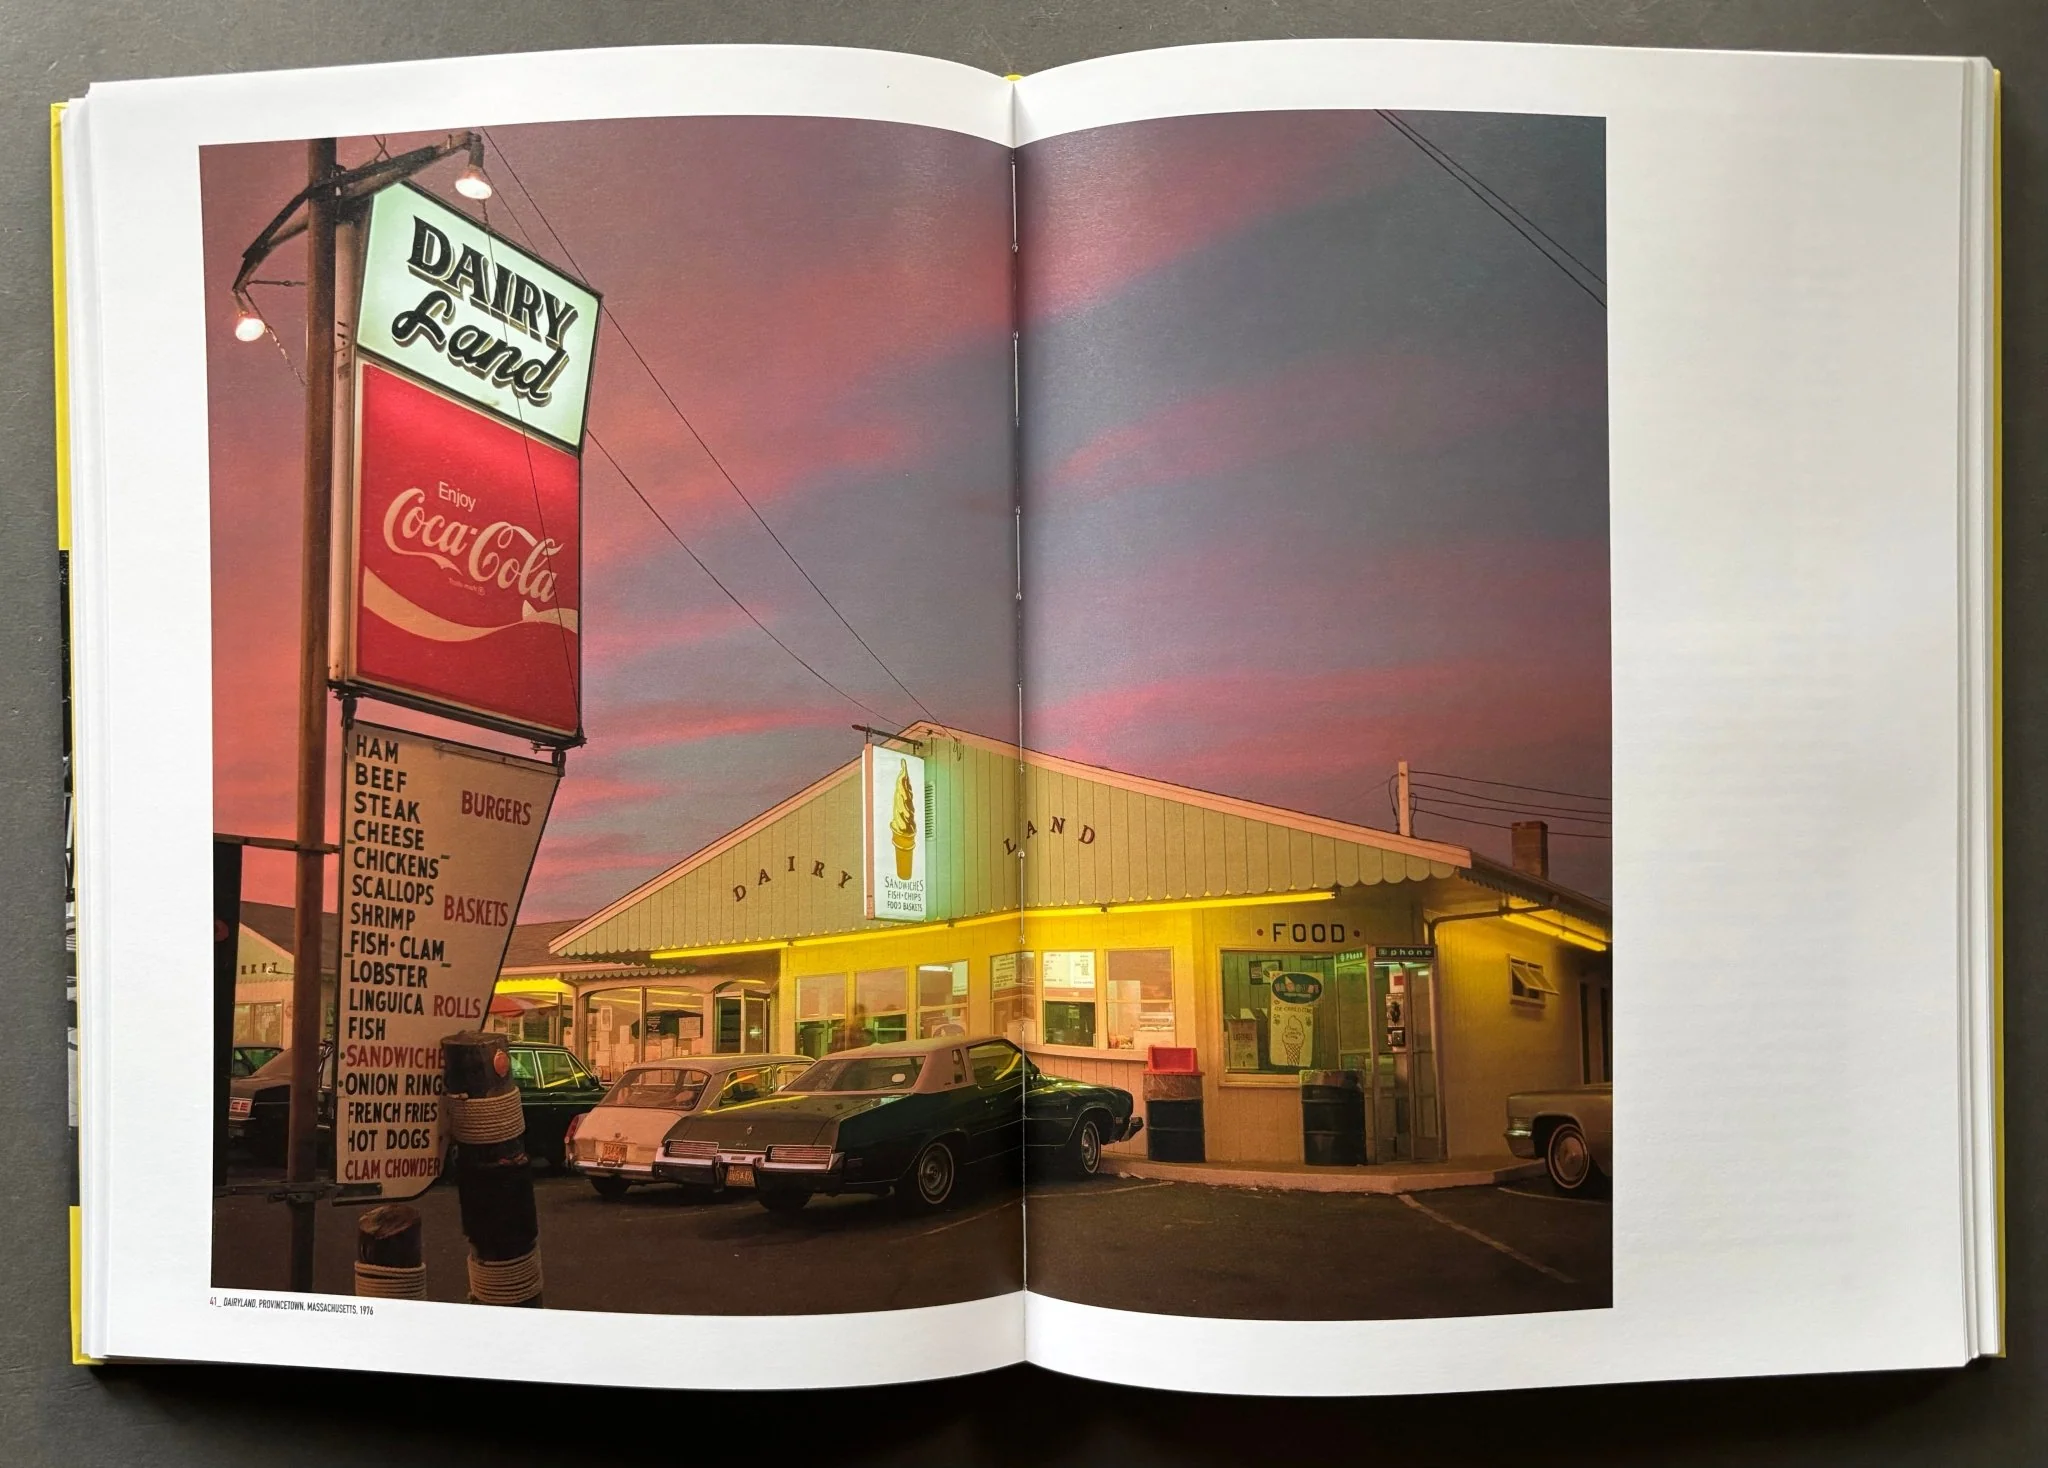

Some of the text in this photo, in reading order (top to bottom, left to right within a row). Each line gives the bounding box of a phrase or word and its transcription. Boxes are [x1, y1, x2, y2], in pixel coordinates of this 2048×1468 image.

[407, 215, 579, 350] DAIRY
[391, 290, 570, 407] Land
[438, 481, 477, 512] Enjoy
[383, 488, 565, 602] Coca-Cola
[356, 734, 399, 764] HAM
[355, 762, 407, 793] BEEF
[354, 791, 421, 824] STEAK
[461, 790, 532, 826] BURGERS
[353, 820, 425, 851] CHEESE
[353, 847, 439, 880] CHICKENS
[732, 815, 1096, 902] DAIRY LAND
[352, 874, 434, 906] SCALLOPS
[885, 876, 923, 891] SANDWICHES
[350, 902, 416, 931] SHRIMP
[443, 895, 509, 927] BASKETS
[903, 903, 922, 911] BASKETS
[1272, 923, 1346, 943] FOOD
[1390, 948, 1432, 957] phone
[349, 961, 428, 988] LOBSTER
[349, 988, 481, 1019] LINGUICA ROLLS
[348, 1016, 386, 1041] FISH
[346, 1044, 446, 1070] SANDWICHE
[345, 1072, 447, 1096] ONION RING
[348, 1102, 438, 1124] FRENCH FRIES
[348, 1128, 430, 1152] HOT DOGS
[345, 1157, 442, 1181] CLAM CHOWDER
[359, 1305, 374, 1316] 1976
